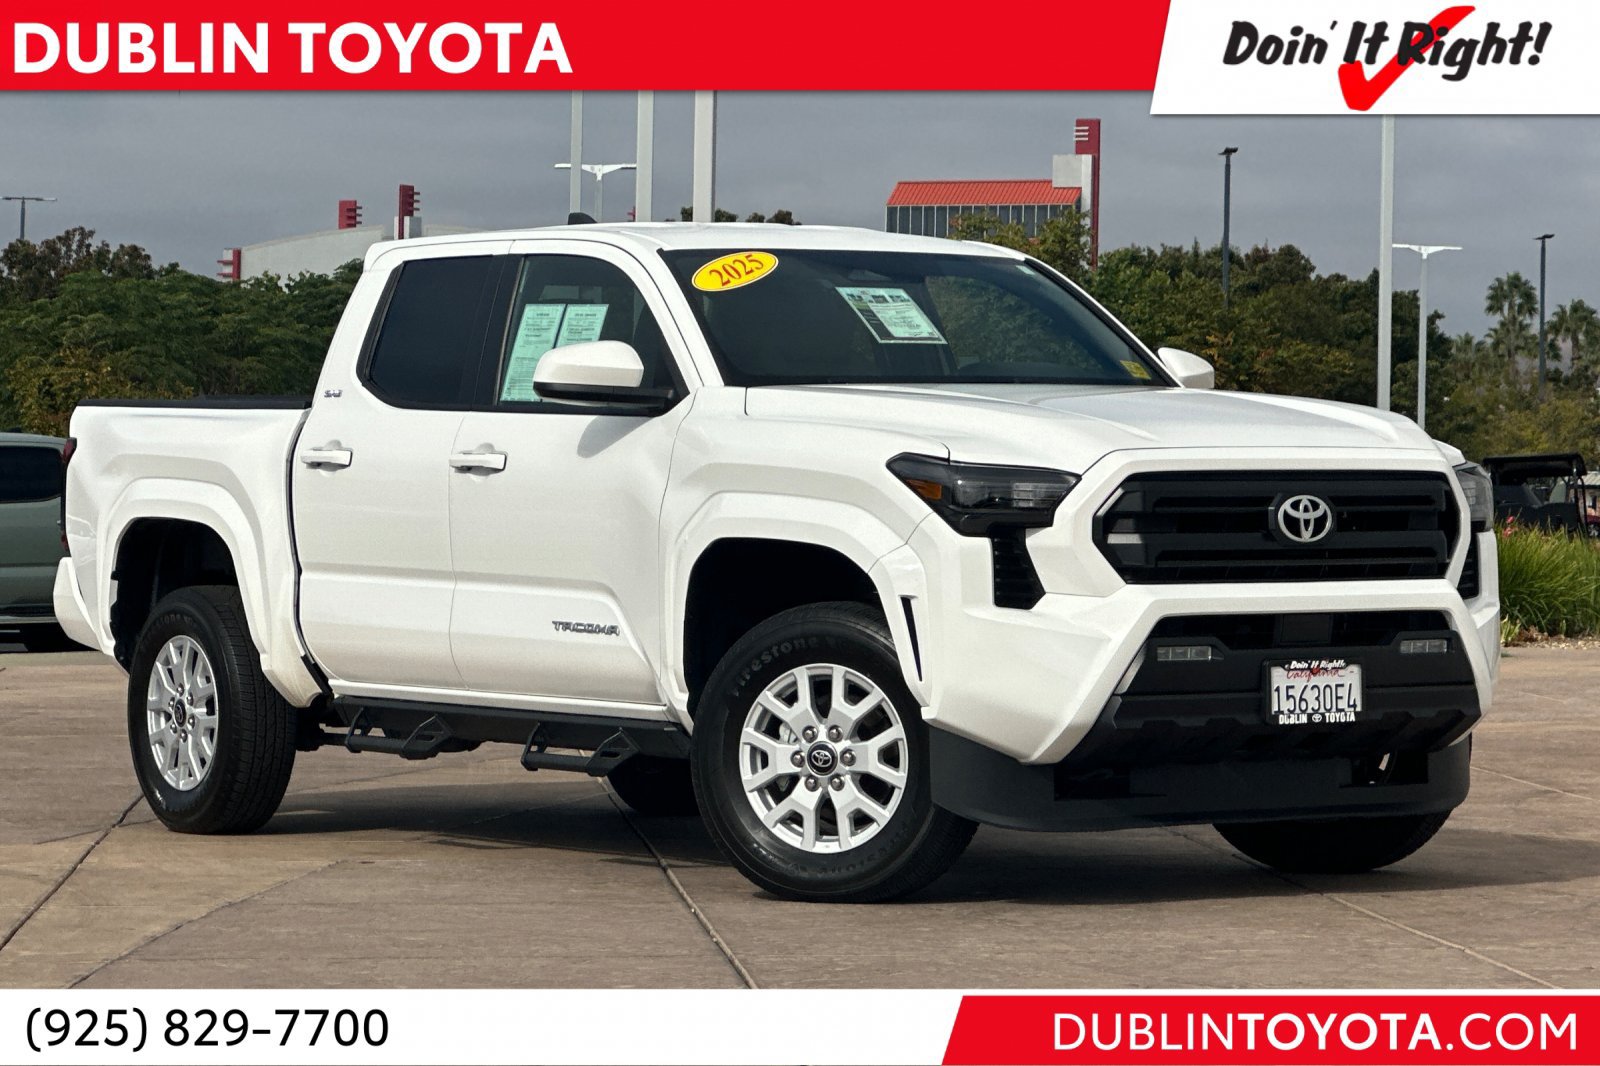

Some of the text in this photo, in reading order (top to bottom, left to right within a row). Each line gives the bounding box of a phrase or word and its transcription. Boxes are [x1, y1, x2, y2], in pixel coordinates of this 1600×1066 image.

[709, 253, 764, 287] 2025
[552, 620, 620, 637] TACOMA
[1286, 669, 1340, 682] Califrnia
[1274, 683, 1357, 713] 15630E4
[1325, 711, 1356, 723] TOYOTA
